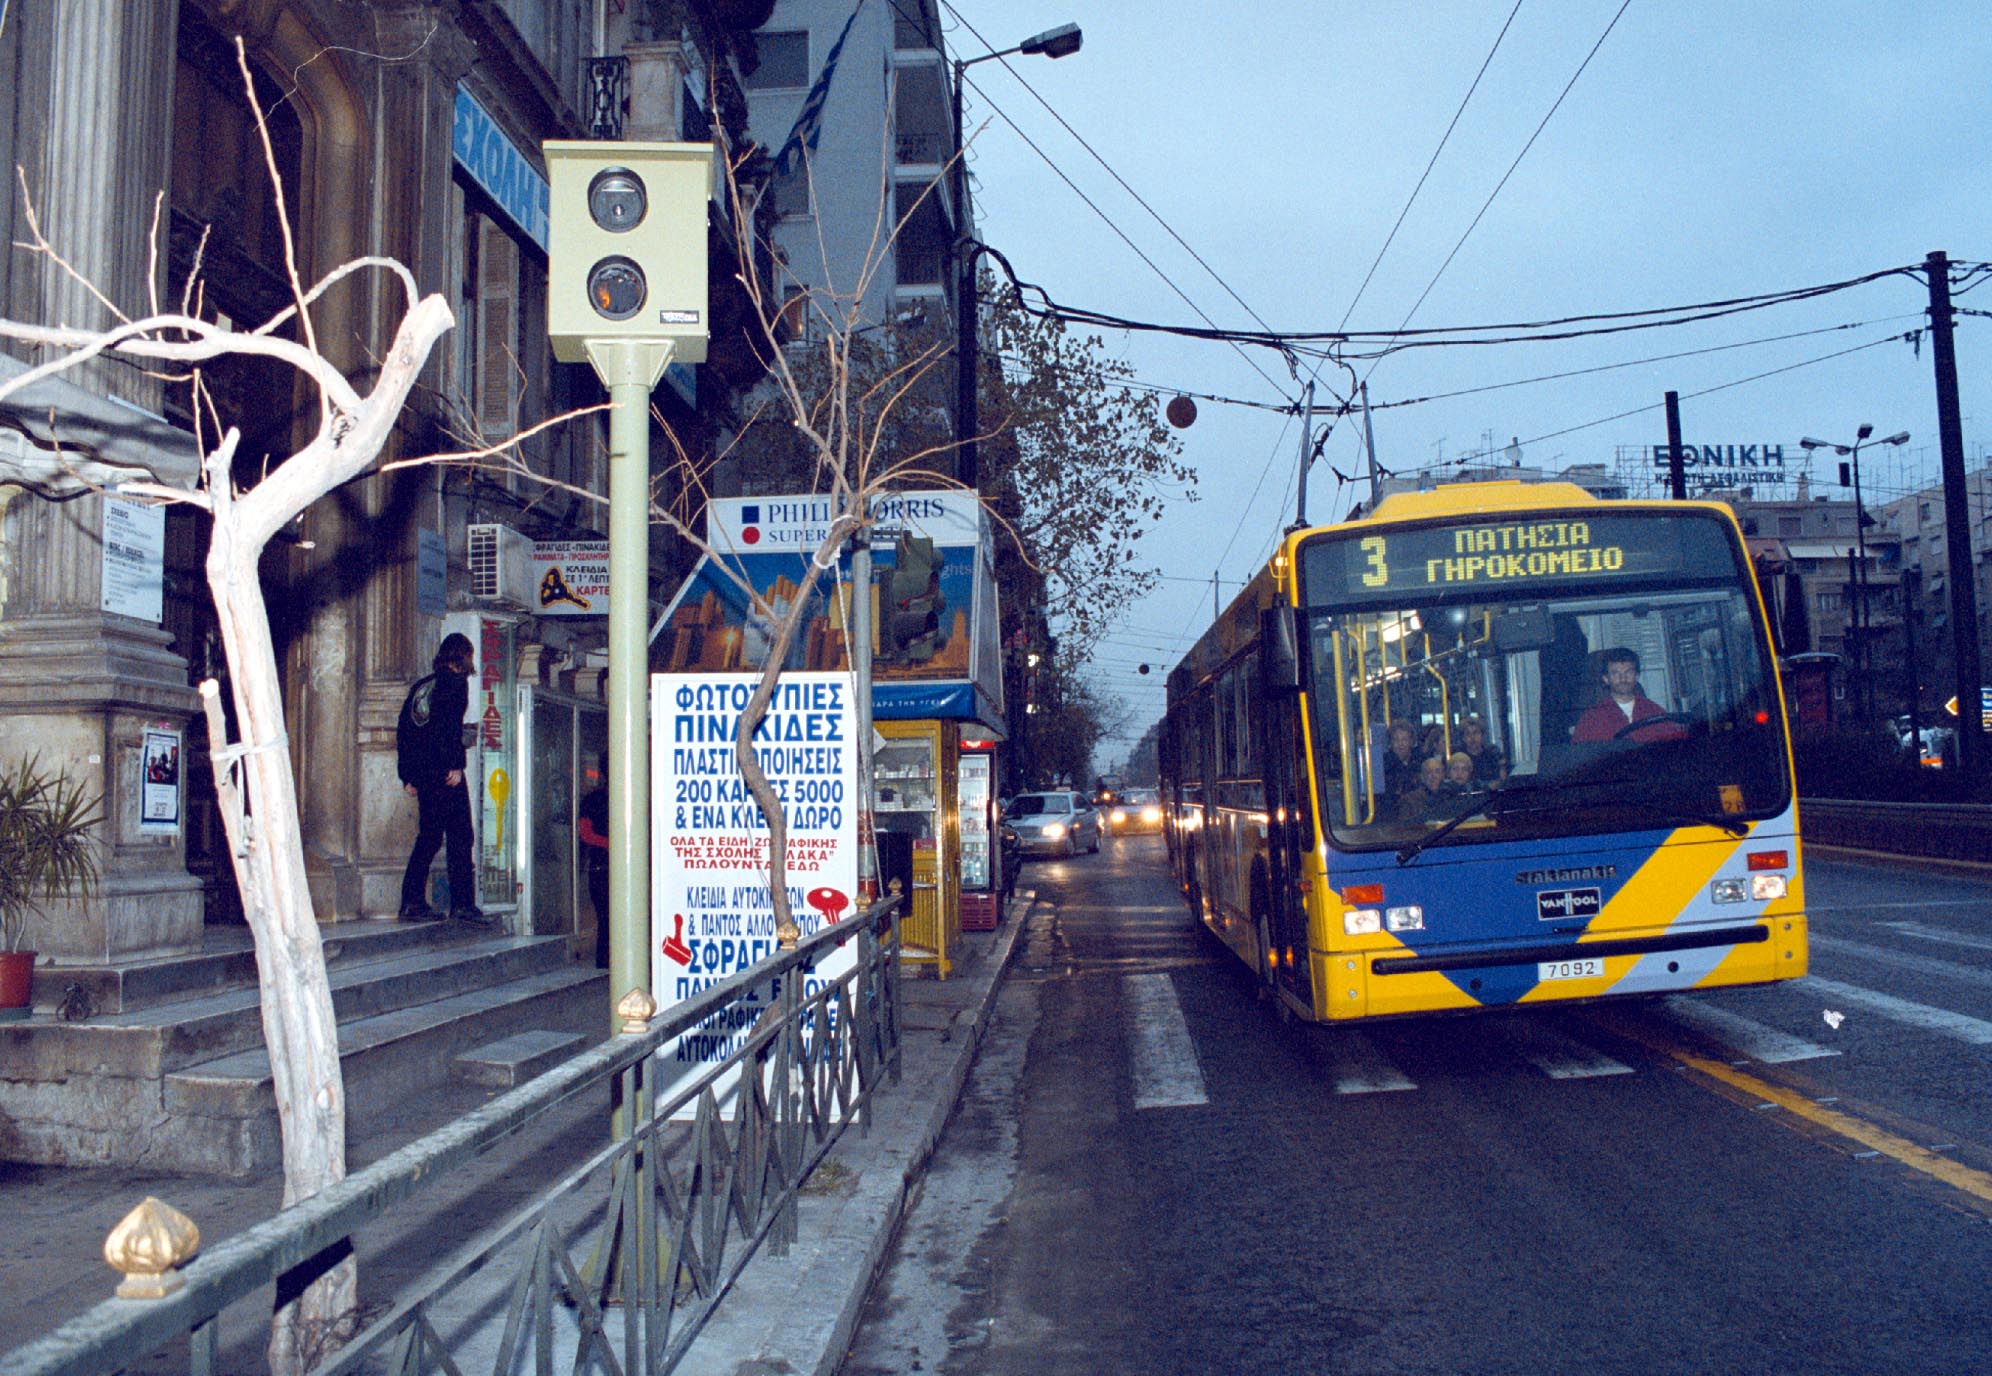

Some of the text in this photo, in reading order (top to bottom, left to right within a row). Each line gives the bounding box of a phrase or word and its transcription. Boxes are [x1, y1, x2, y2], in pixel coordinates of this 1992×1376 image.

[1653, 444, 1782, 468] ΕΘΝΙΚΗ
[872, 498, 945, 520] ORRIS
[533, 543, 570, 552] ΦΡΑΓΙΔΕΣ
[768, 530, 828, 543] SUPER
[1360, 522, 1590, 587] 3 ΠΑΤΗΣΙΑ
[1427, 547, 1624, 583] ΓΗΡΟΚΟΜΕΙΟ
[566, 566, 607, 574] ΚΛΕΙΔΙΑ
[482, 619, 502, 748] ΣΦΡΑΓΙΔΕΣ
[674, 747, 843, 775] ΠΛΑΣΤΙΠΟΙΗΣΕΙΣ
[676, 779, 712, 803] 200
[794, 779, 843, 803] 5000
[675, 805, 842, 830] & ΕΝΑ ΚΛΕΙ ΔΩΡΟ
[670, 836, 838, 849] ΟΛΑ ΤΑ ΕΙΔΗ ΖΩΑΦΙΚΗΣ
[675, 847, 834, 861] ΤΗΣ ΣΧΟΛΗΣ ΛΑΚΑ"
[684, 859, 820, 872] ΠΩΛΟΥΝΤΑ ΕΔΩ
[687, 886, 804, 909] ΚΛΕΙΔΙΑ ΑΥΤΟΚΙΝΤΩΝ
[688, 914, 821, 936] & ΠΑΝΤΟΣ ΑΛΛΟ ΥΠΟΥ
[1548, 961, 1595, 978] 7092
